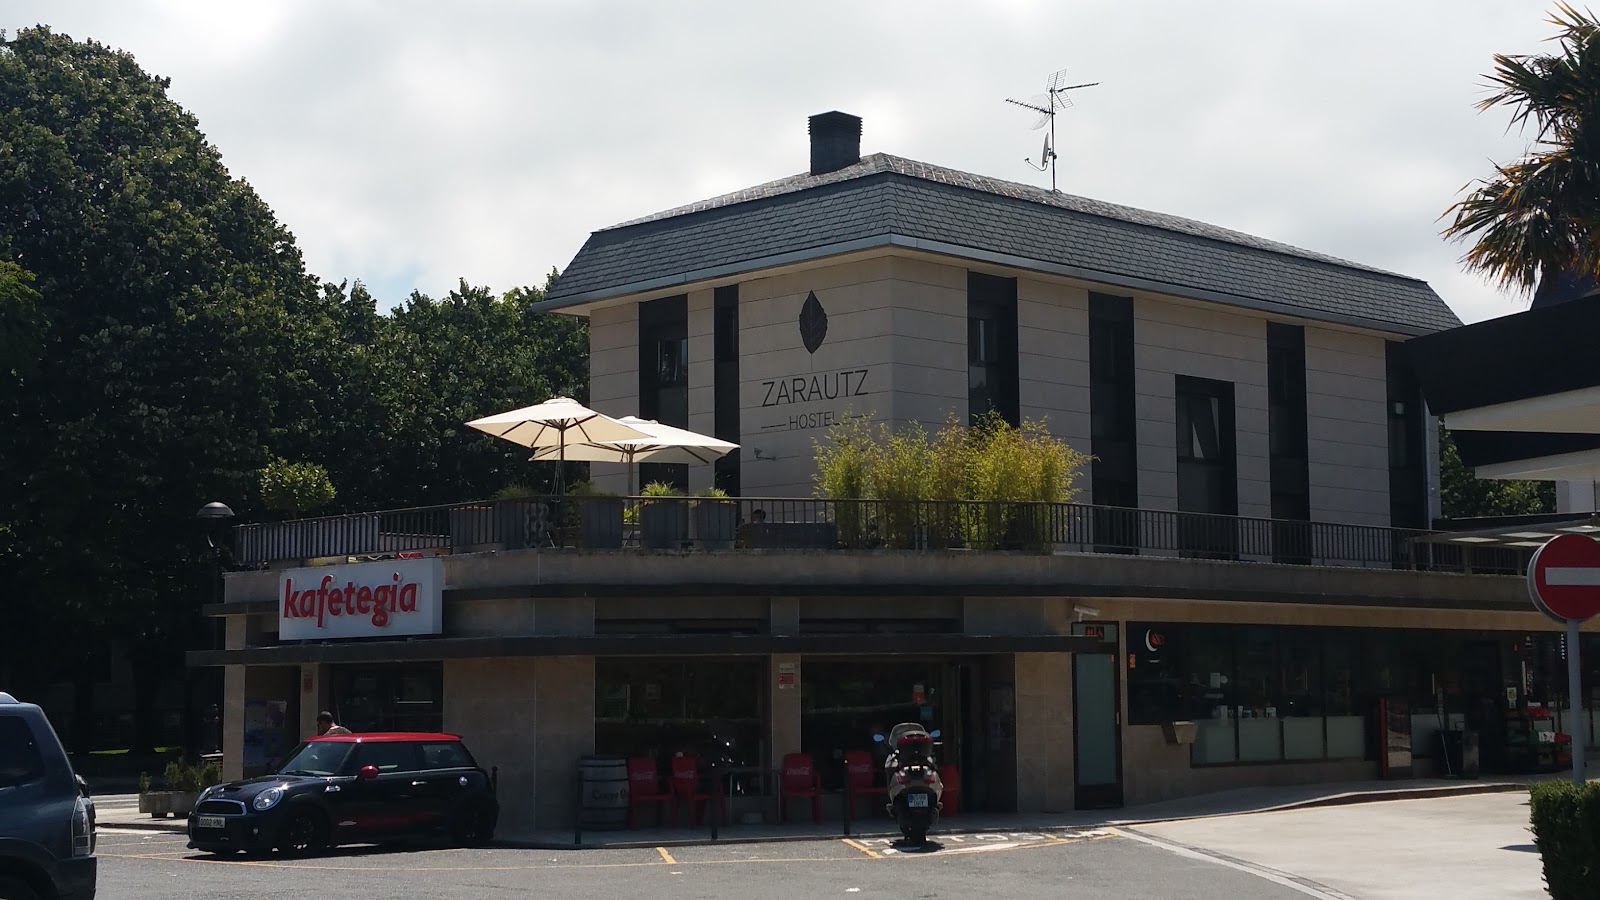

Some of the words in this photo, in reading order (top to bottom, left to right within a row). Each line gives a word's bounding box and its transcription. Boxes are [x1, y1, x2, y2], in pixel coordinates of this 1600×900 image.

[762, 369, 869, 407] ZARAUTZ
[789, 411, 840, 431] HOSTEL
[283, 572, 419, 627] kafetegia
[858, 832, 1045, 846] MTOS
